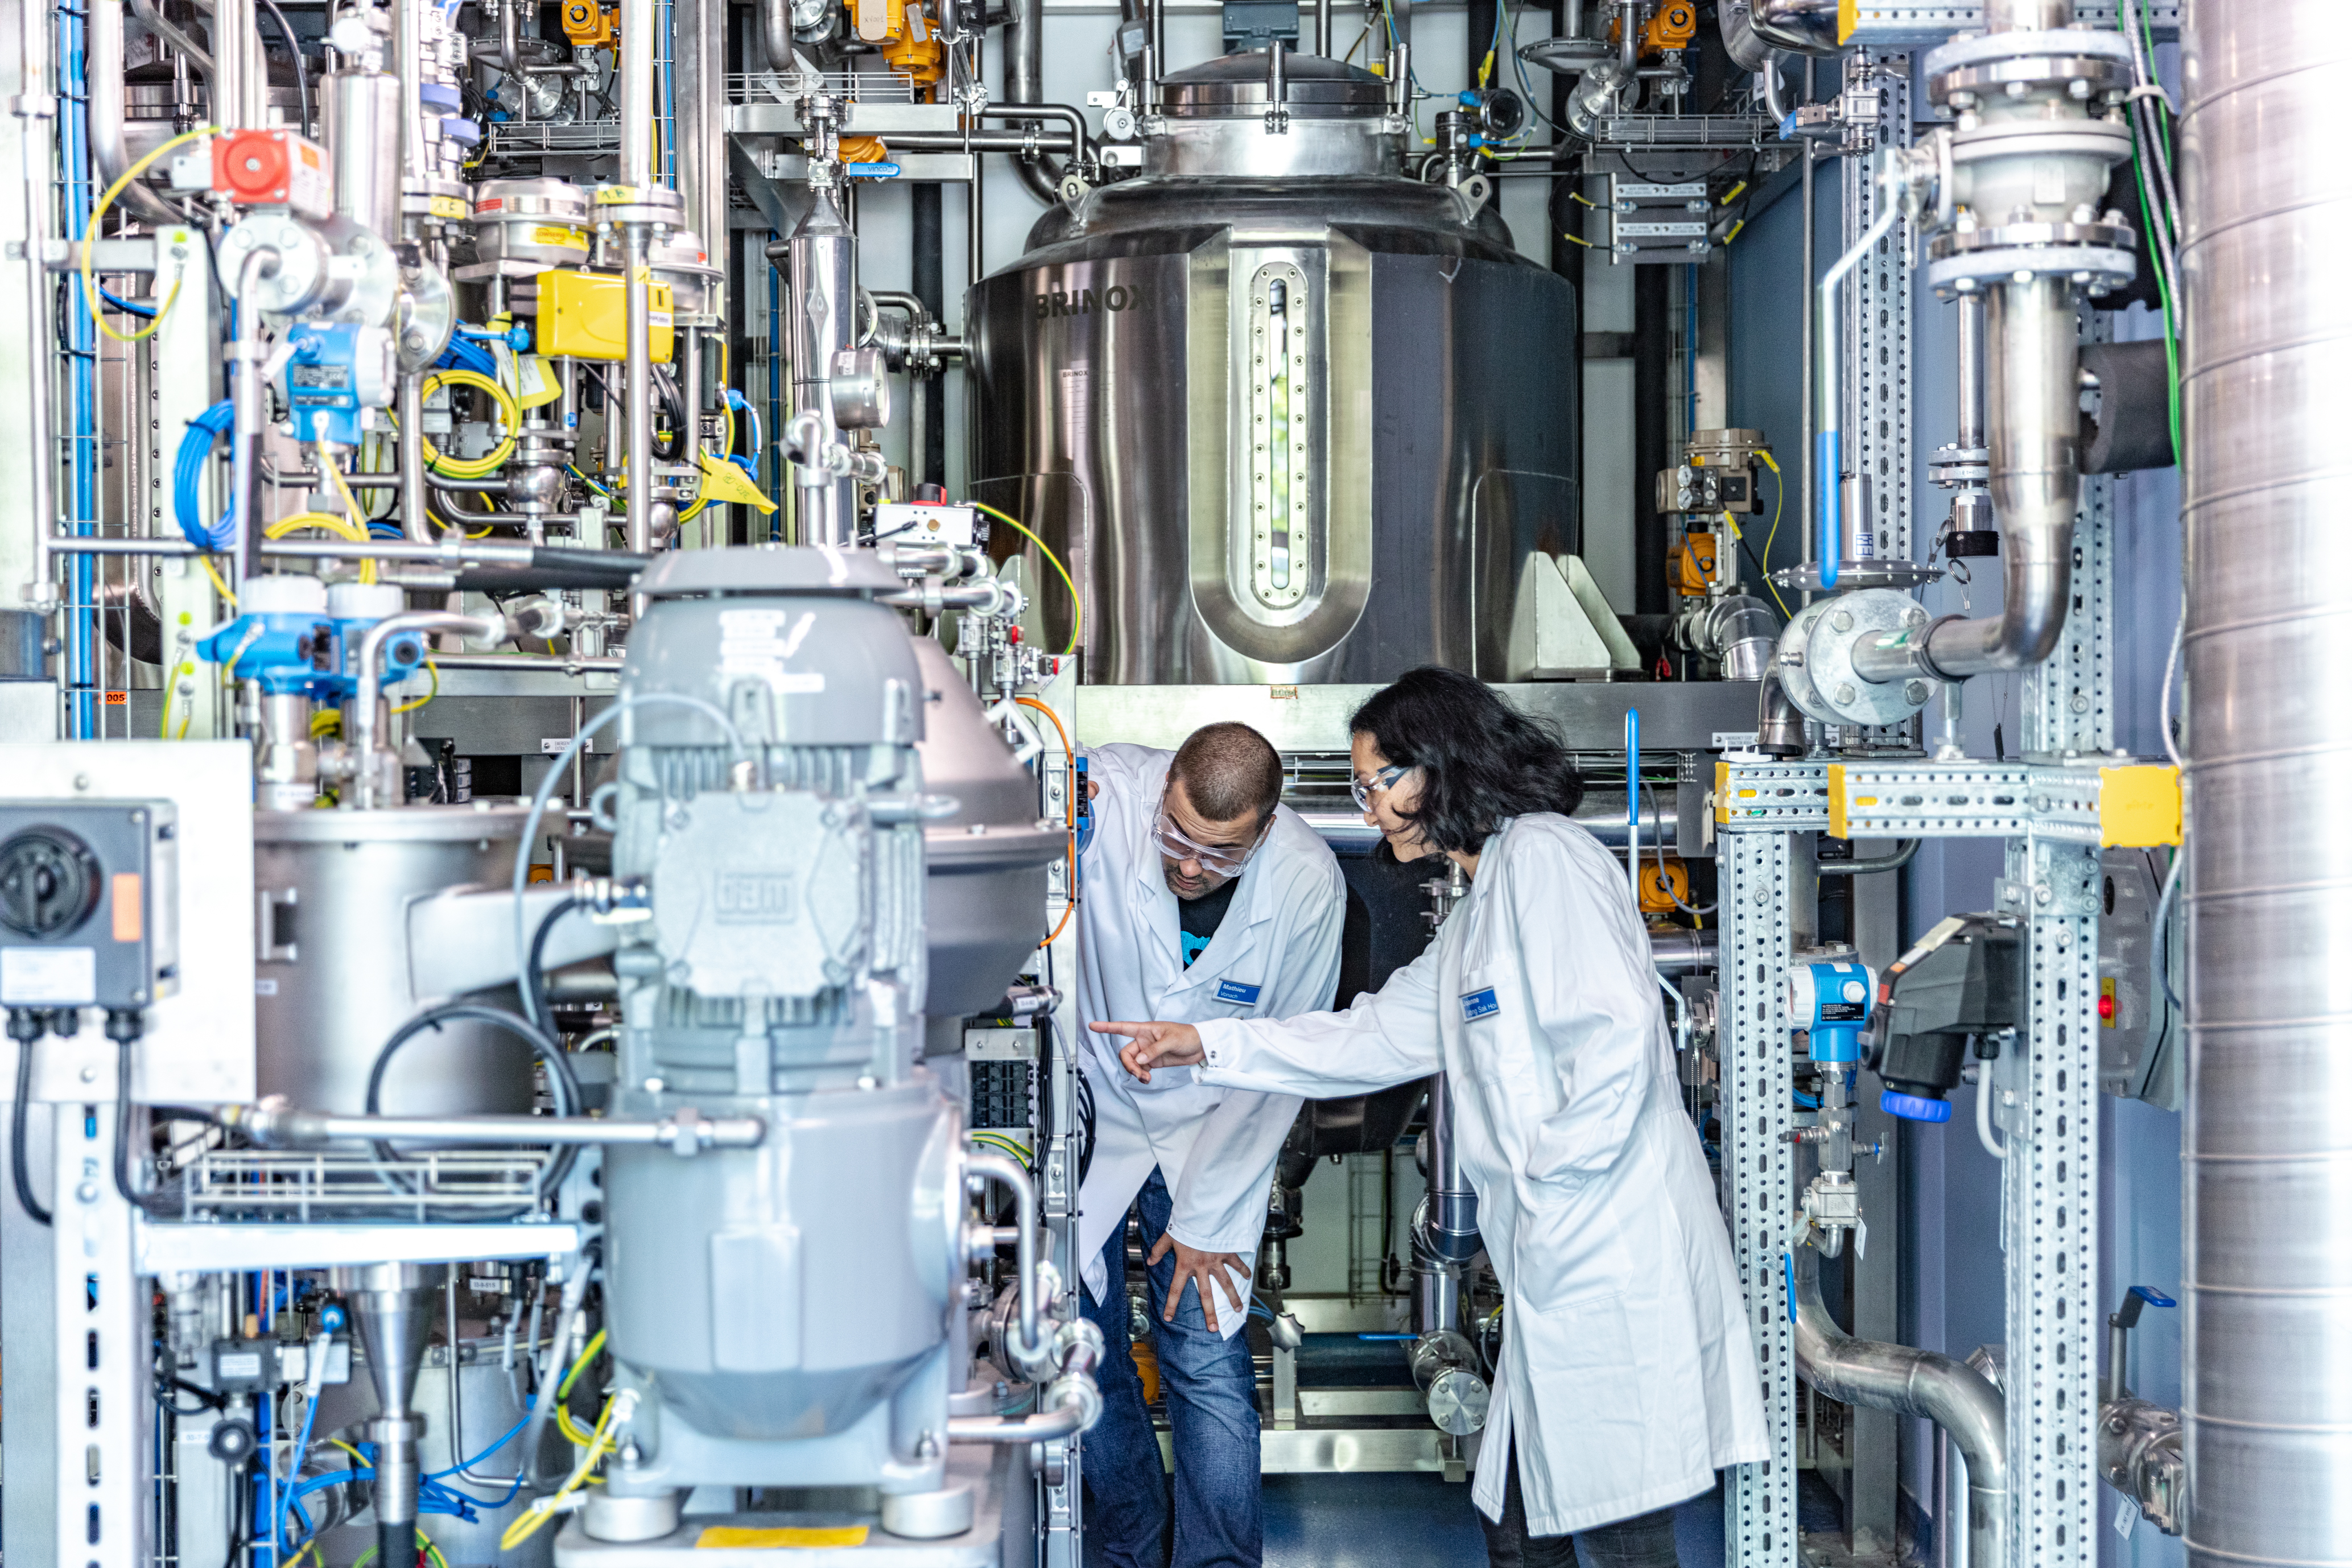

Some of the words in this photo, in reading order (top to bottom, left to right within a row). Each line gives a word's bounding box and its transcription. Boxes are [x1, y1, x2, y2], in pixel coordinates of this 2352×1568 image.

[1222, 984, 1247, 993] Mathieu
[1220, 991, 1239, 999] Vonach
[1477, 1005, 1488, 1013] Sak
[1487, 1001, 1497, 1010] Hoi
